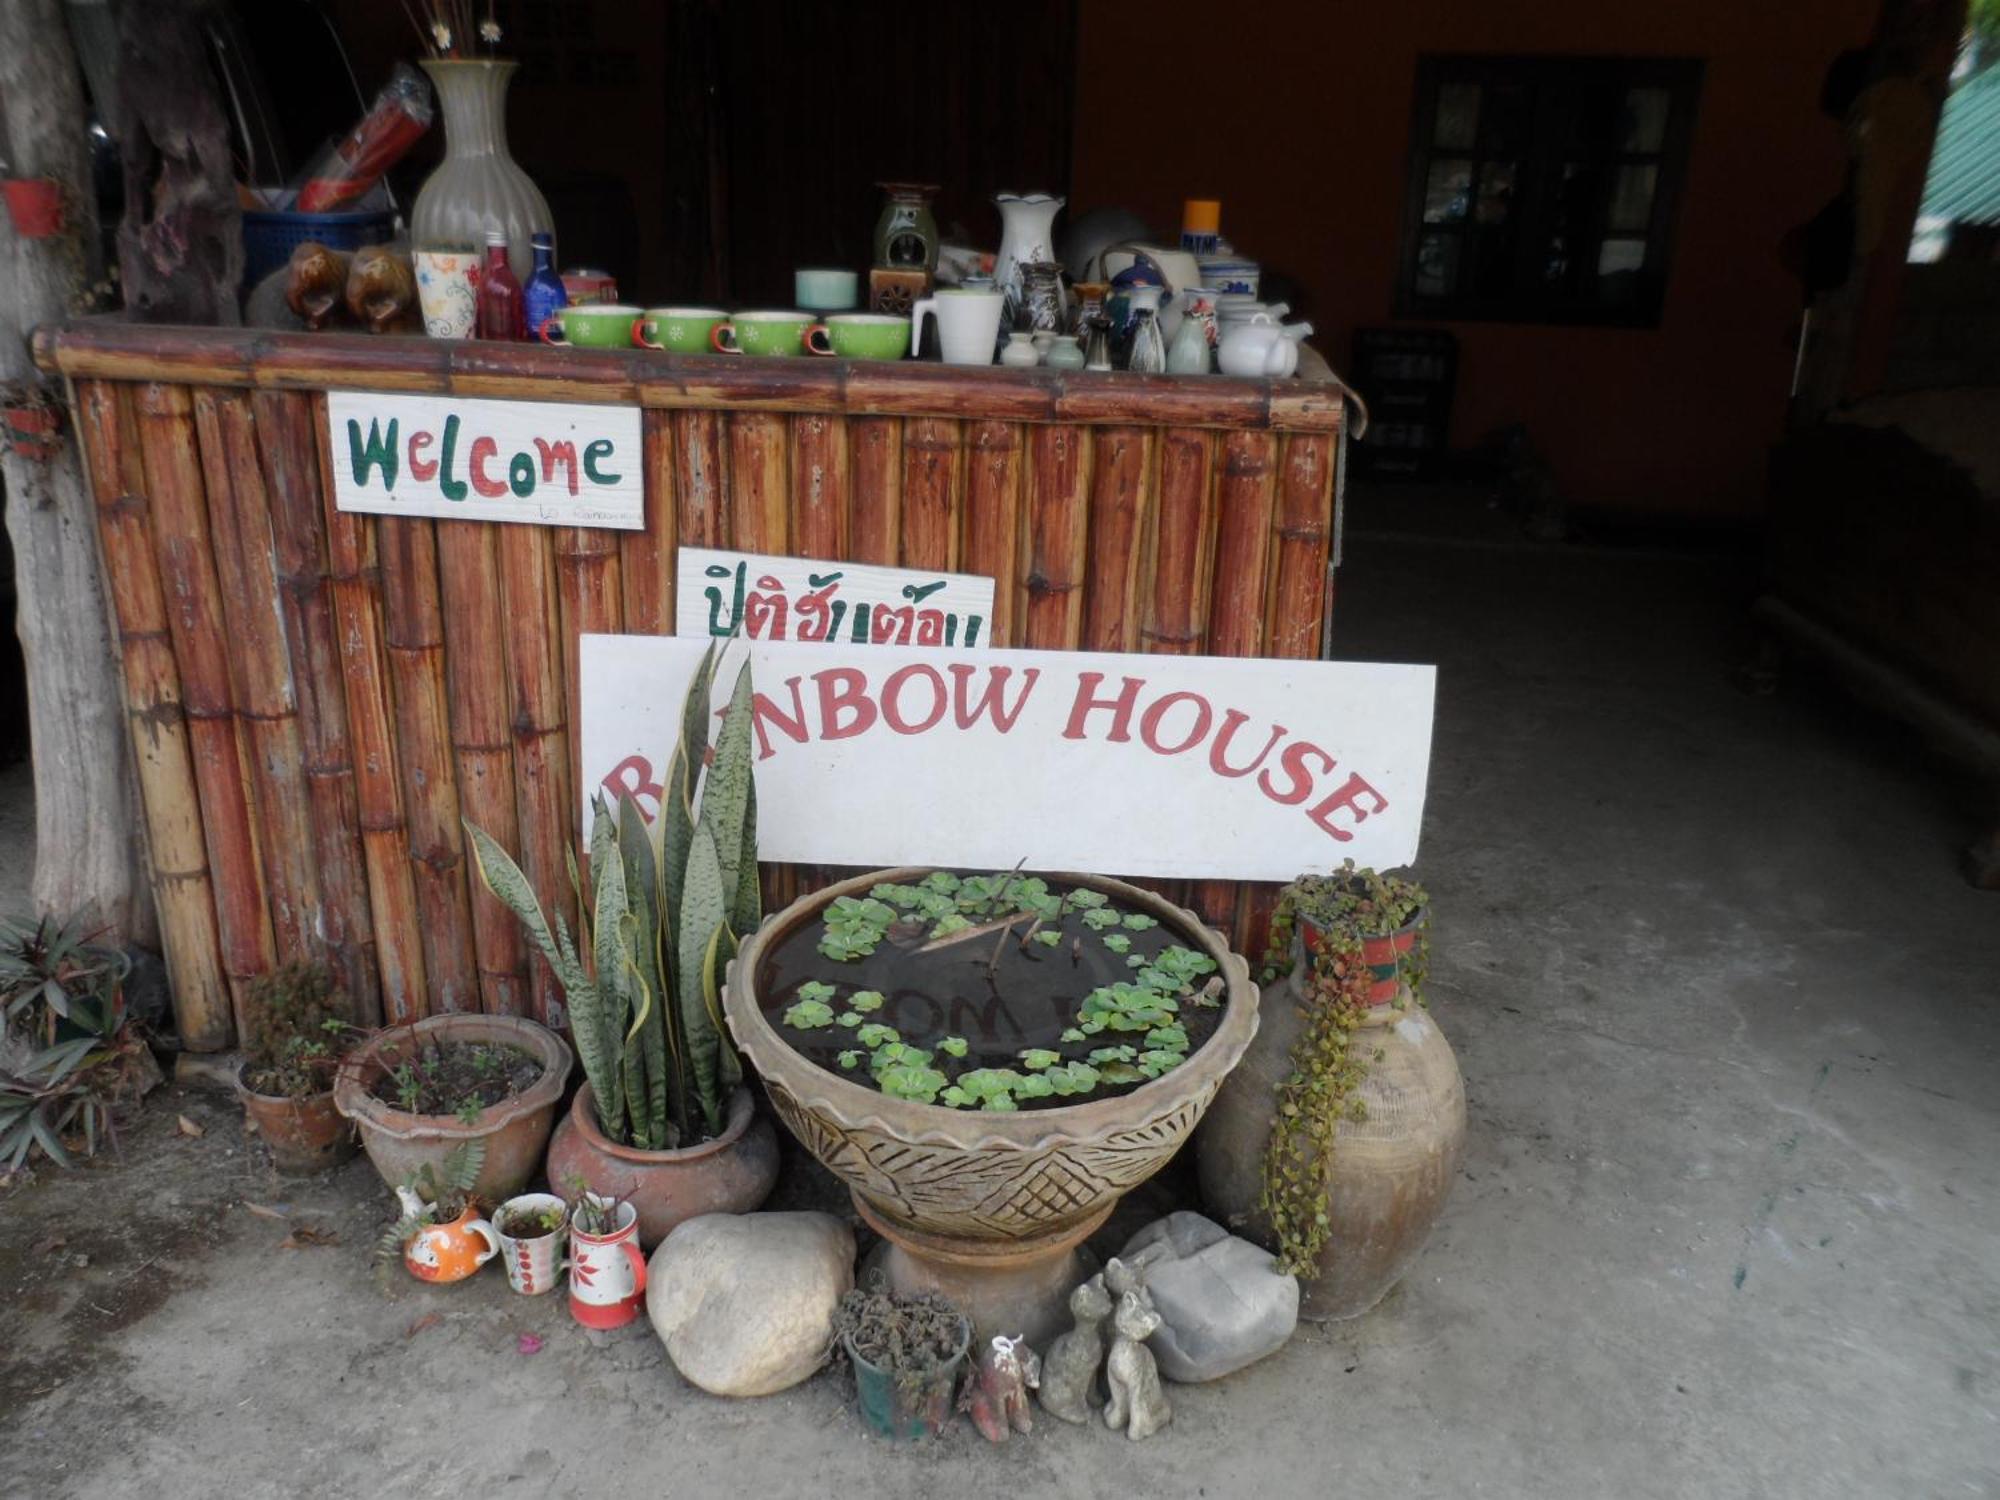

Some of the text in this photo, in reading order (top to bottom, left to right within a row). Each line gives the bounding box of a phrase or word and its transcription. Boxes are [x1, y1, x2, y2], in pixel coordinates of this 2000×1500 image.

[347, 414, 622, 501] Welcome
[601, 663, 1389, 842] RNBOW HOUSE
